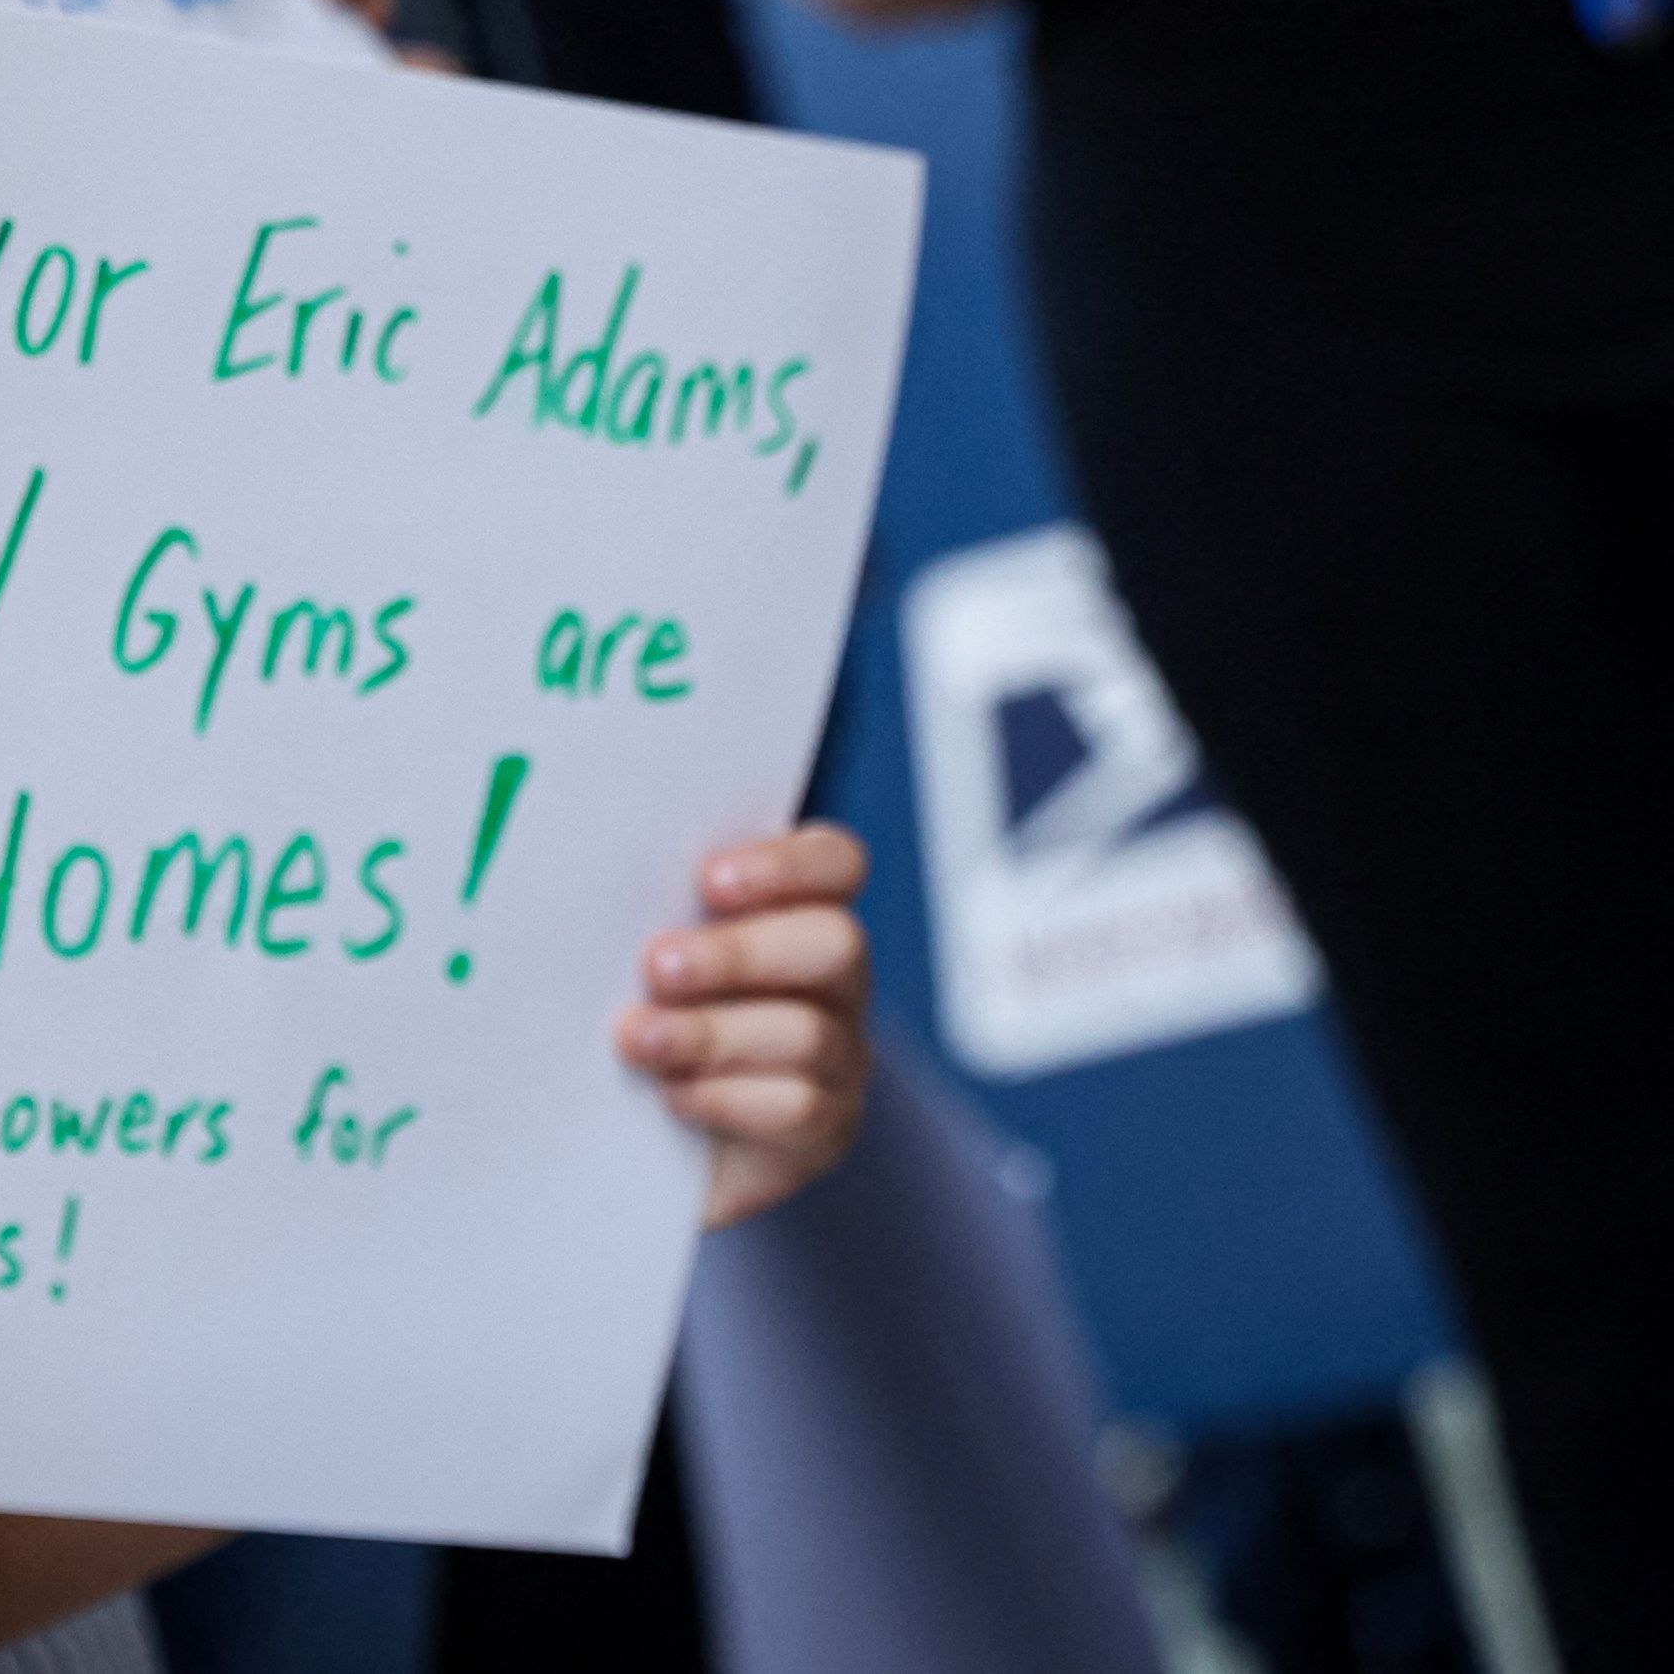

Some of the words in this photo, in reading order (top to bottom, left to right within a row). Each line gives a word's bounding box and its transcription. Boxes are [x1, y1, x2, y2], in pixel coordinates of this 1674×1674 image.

[210, 216, 420, 384] Eric
[470, 260, 820, 498] Adams,
[110, 525, 417, 734] Gyms
[535, 607, 695, 705] are
[292, 1060, 422, 1169] for
